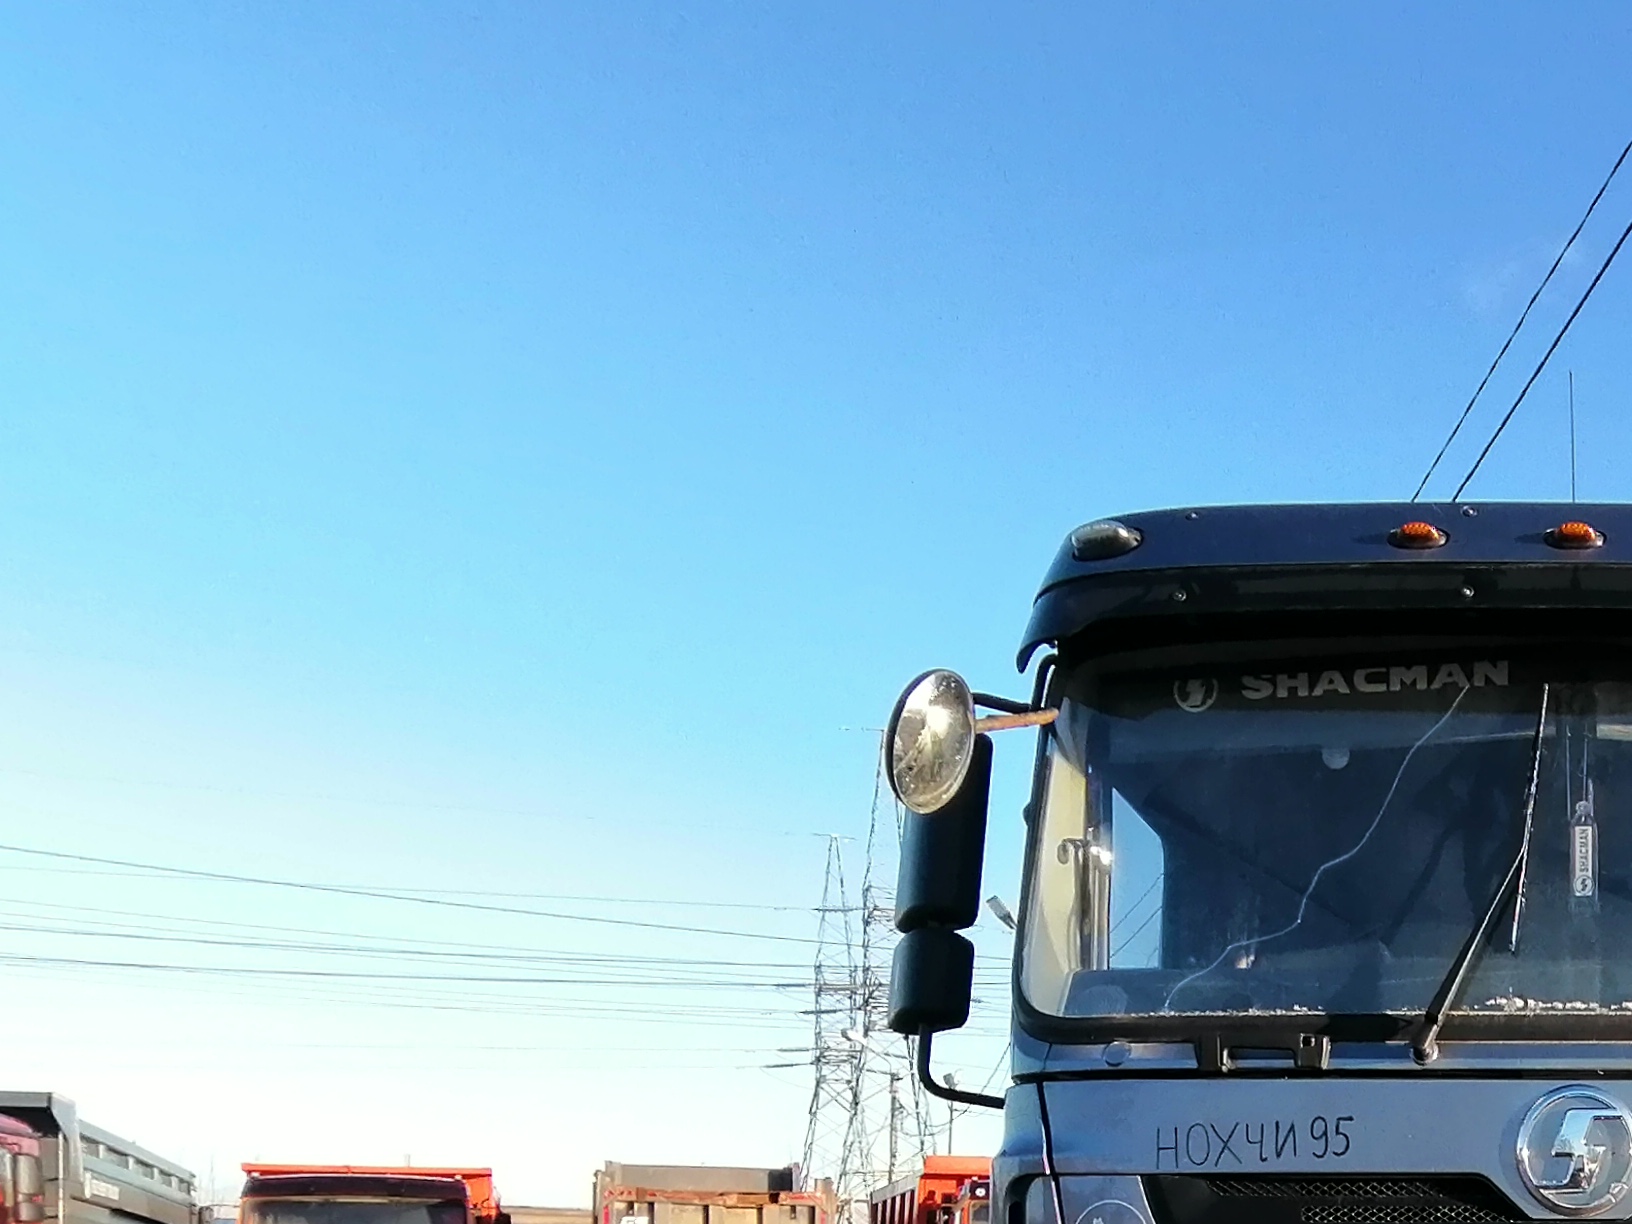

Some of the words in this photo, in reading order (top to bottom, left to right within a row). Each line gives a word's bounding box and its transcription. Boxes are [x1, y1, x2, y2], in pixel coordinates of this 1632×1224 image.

[1241, 661, 1509, 700] SHACMAN
[1155, 1121, 1298, 1170] НОХЧИ
[1310, 1115, 1355, 1159] 95
